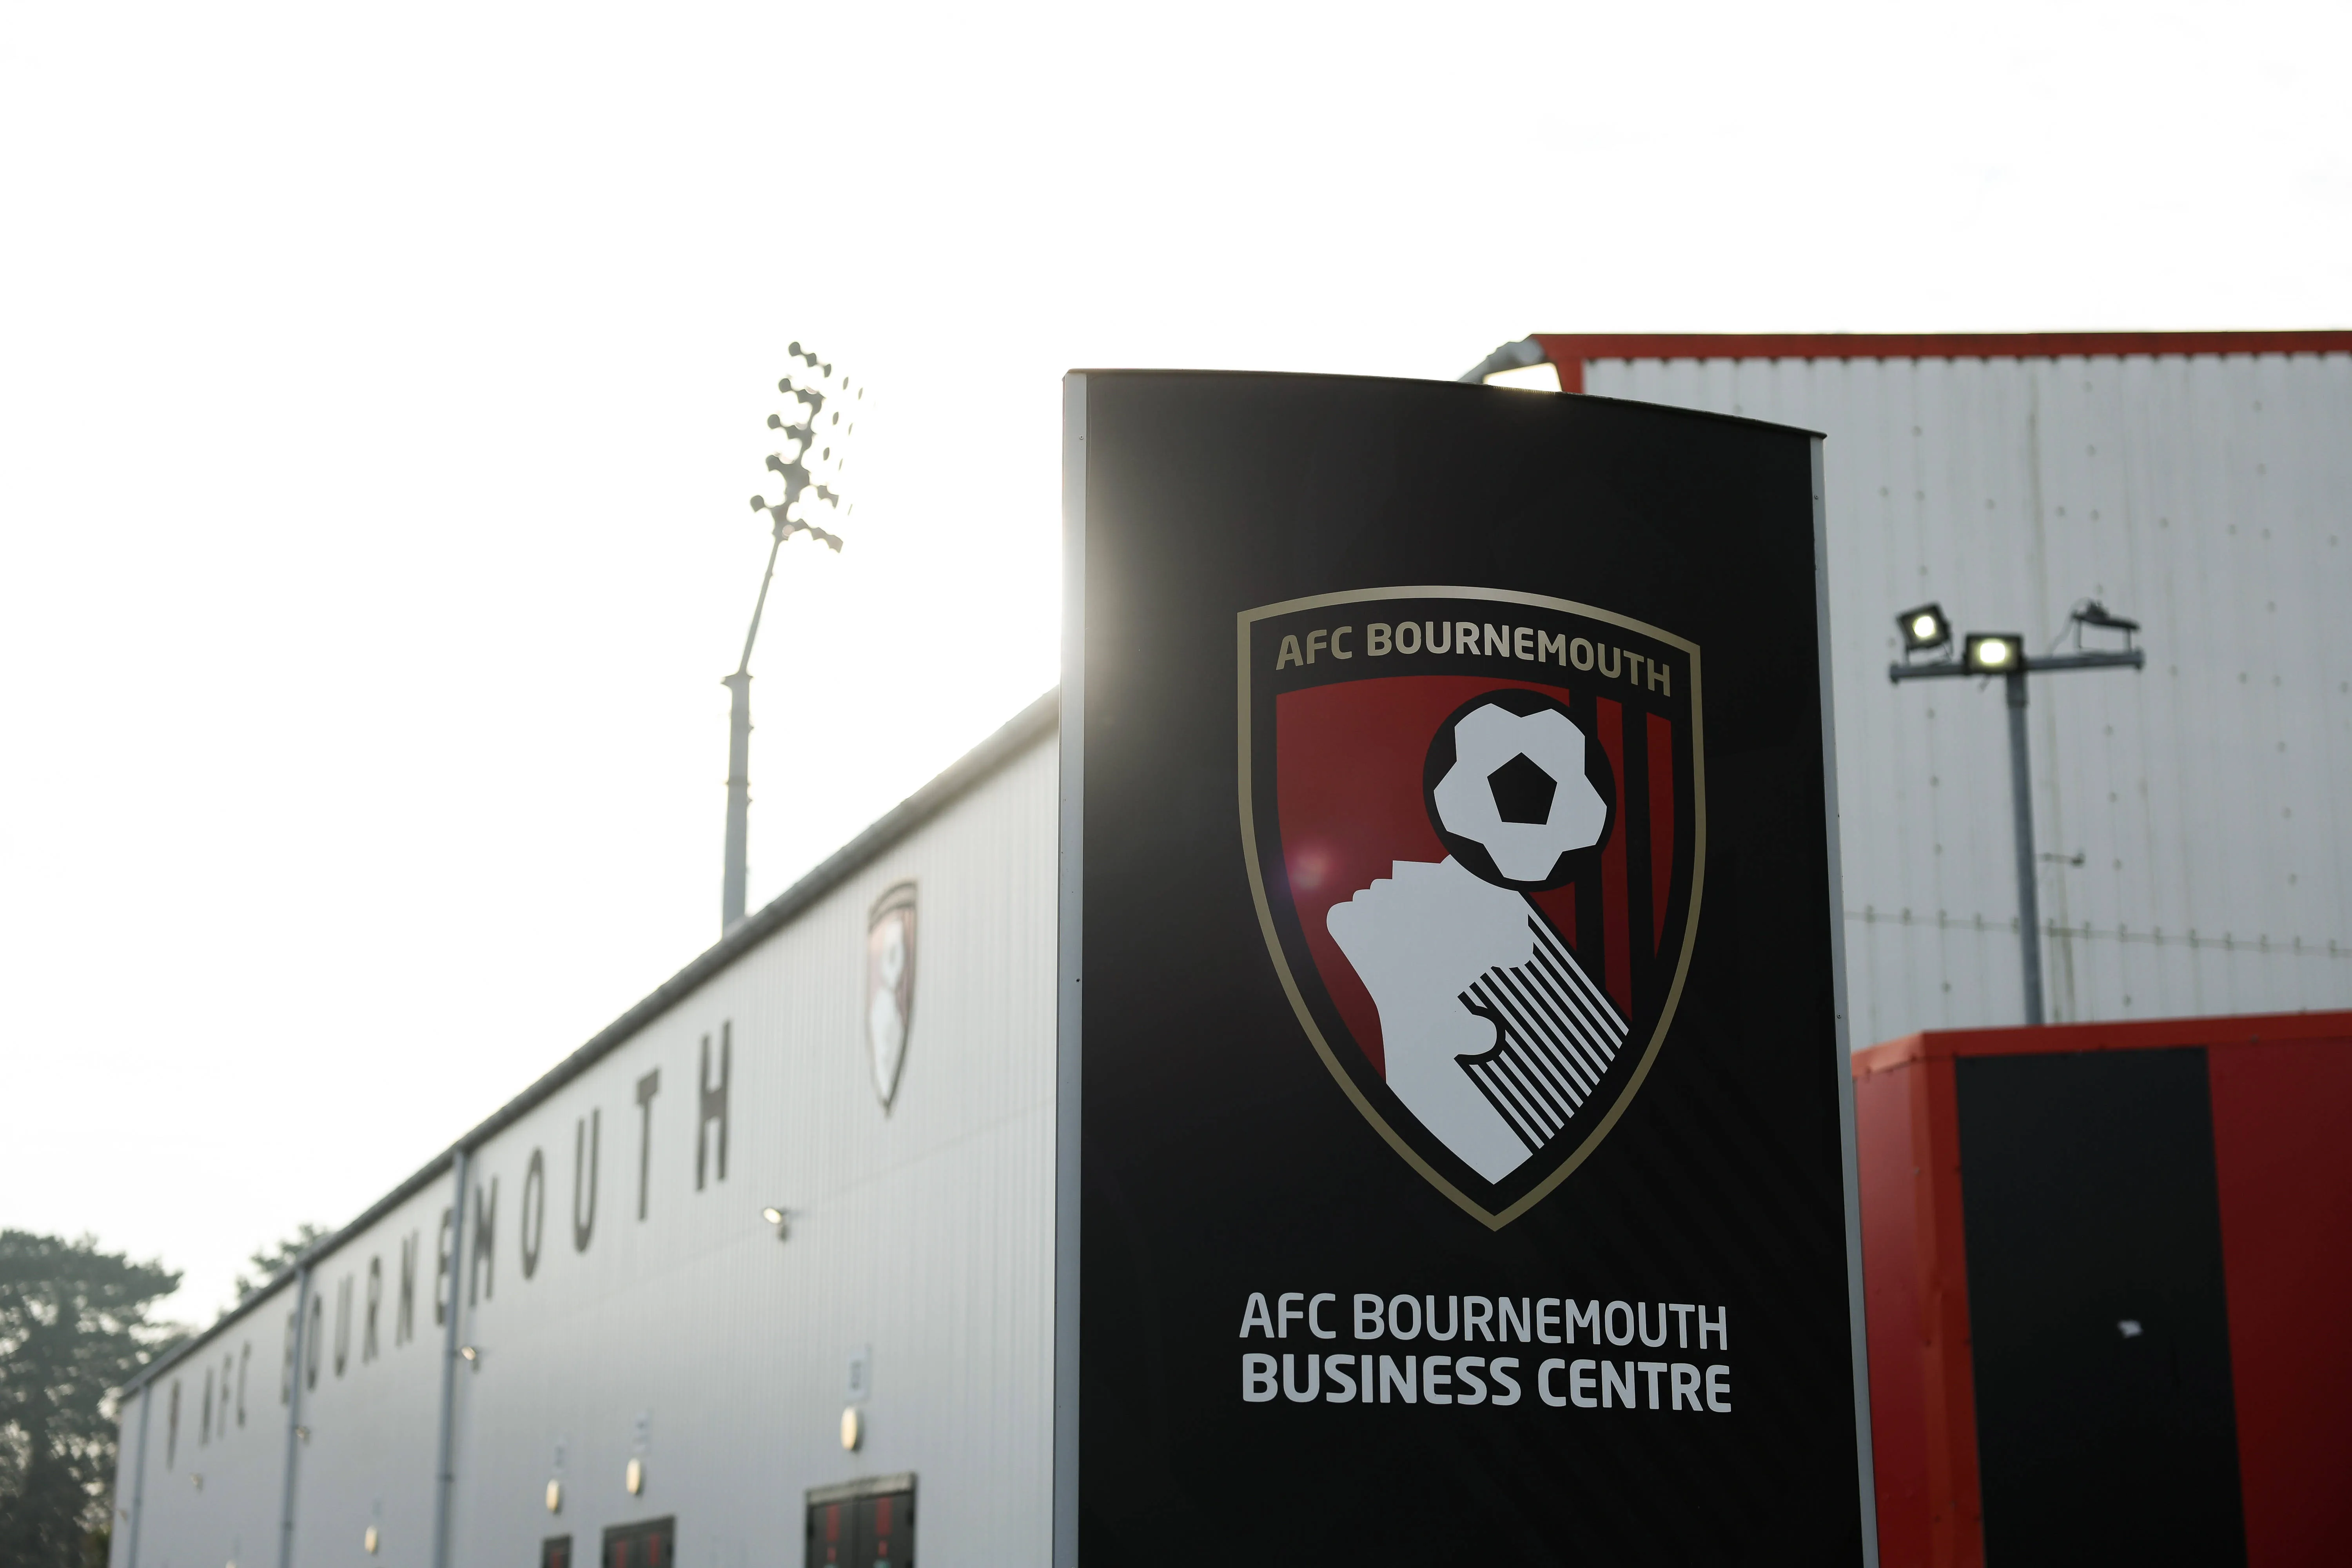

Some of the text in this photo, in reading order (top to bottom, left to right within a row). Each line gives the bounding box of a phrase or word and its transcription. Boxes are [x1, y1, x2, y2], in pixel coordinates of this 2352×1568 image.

[1275, 621, 1670, 697] AFC BOURNEMOUTH
[1239, 1292, 1728, 1351] AFC BOURNEMOUTH
[1242, 1353, 1732, 1413] BUSINESS CENTRE
